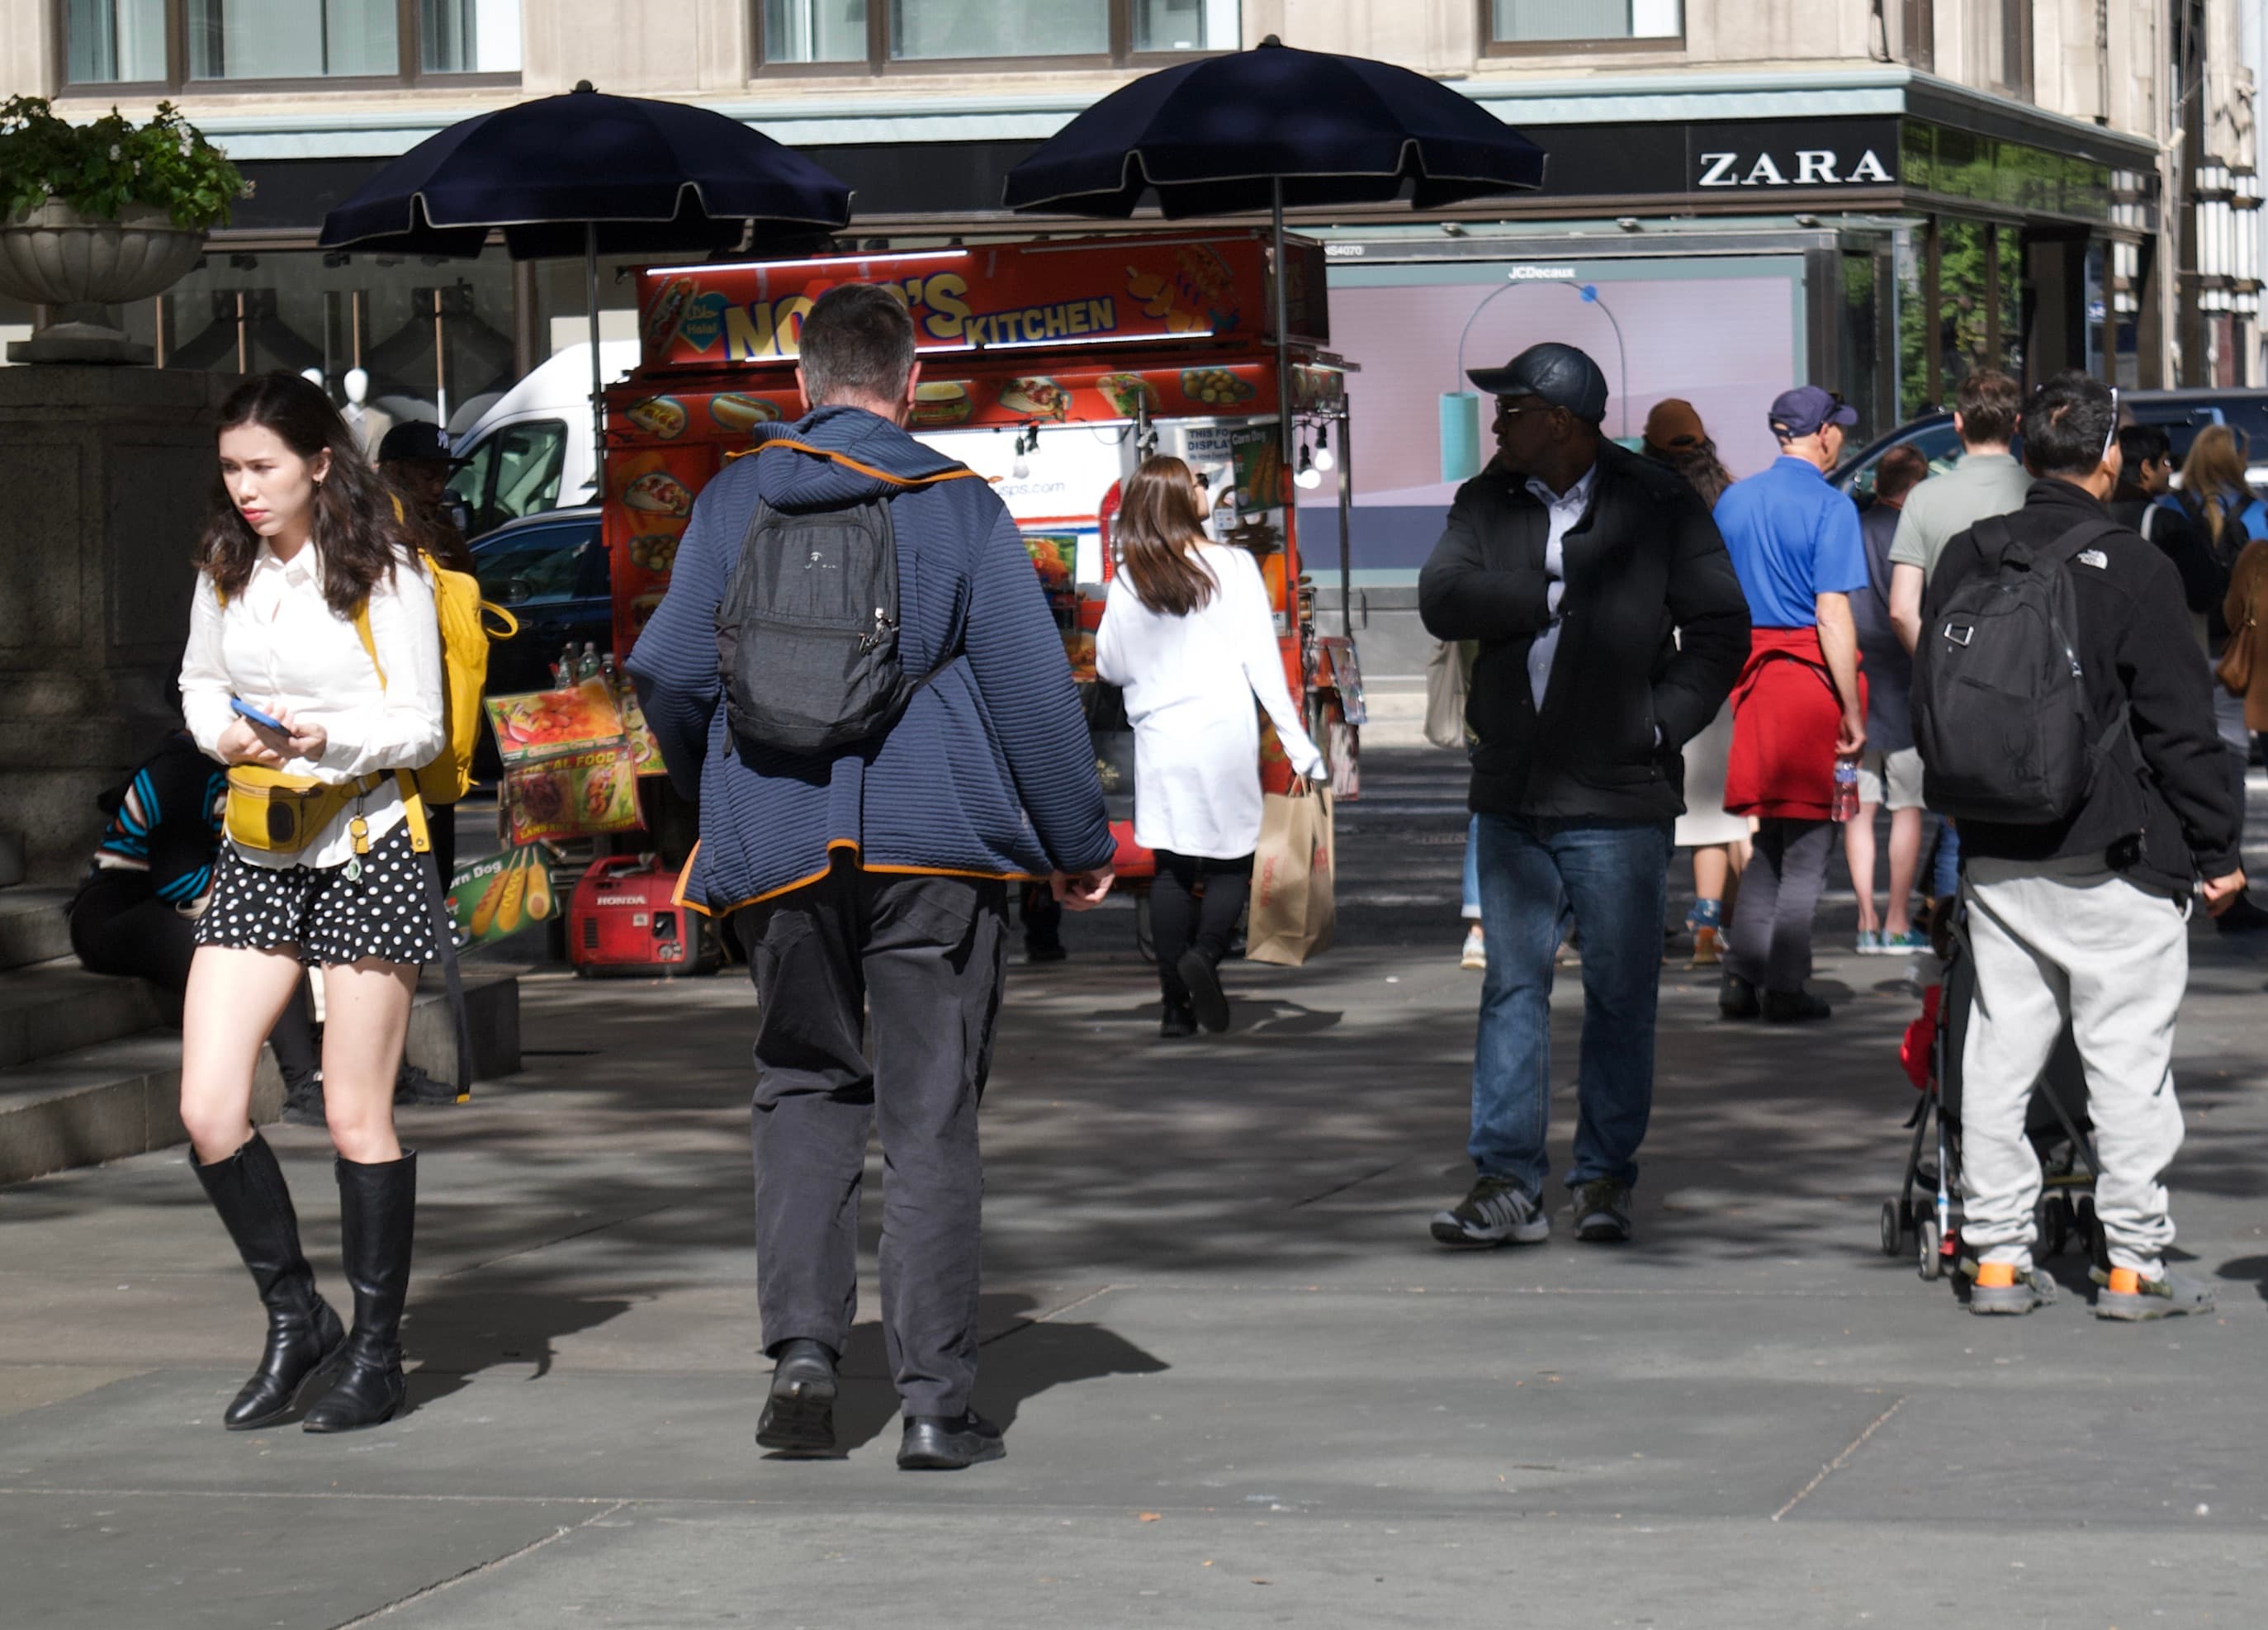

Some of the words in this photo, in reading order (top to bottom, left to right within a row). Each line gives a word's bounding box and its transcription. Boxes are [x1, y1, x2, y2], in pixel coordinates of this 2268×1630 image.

[1697, 149, 1895, 187] ZARA
[1508, 266, 1575, 279] JCDecaux
[723, 272, 973, 361] NO'S
[965, 297, 1115, 345] KITCHEN
[1189, 429, 1213, 439] THIS
[1215, 428, 1229, 438] FO
[1188, 439, 1231, 451] DISPLA
[996, 481, 1065, 498] sps.com
[576, 751, 617, 767] FOOD
[473, 860, 503, 879] Dog
[597, 895, 646, 906] HONDA
